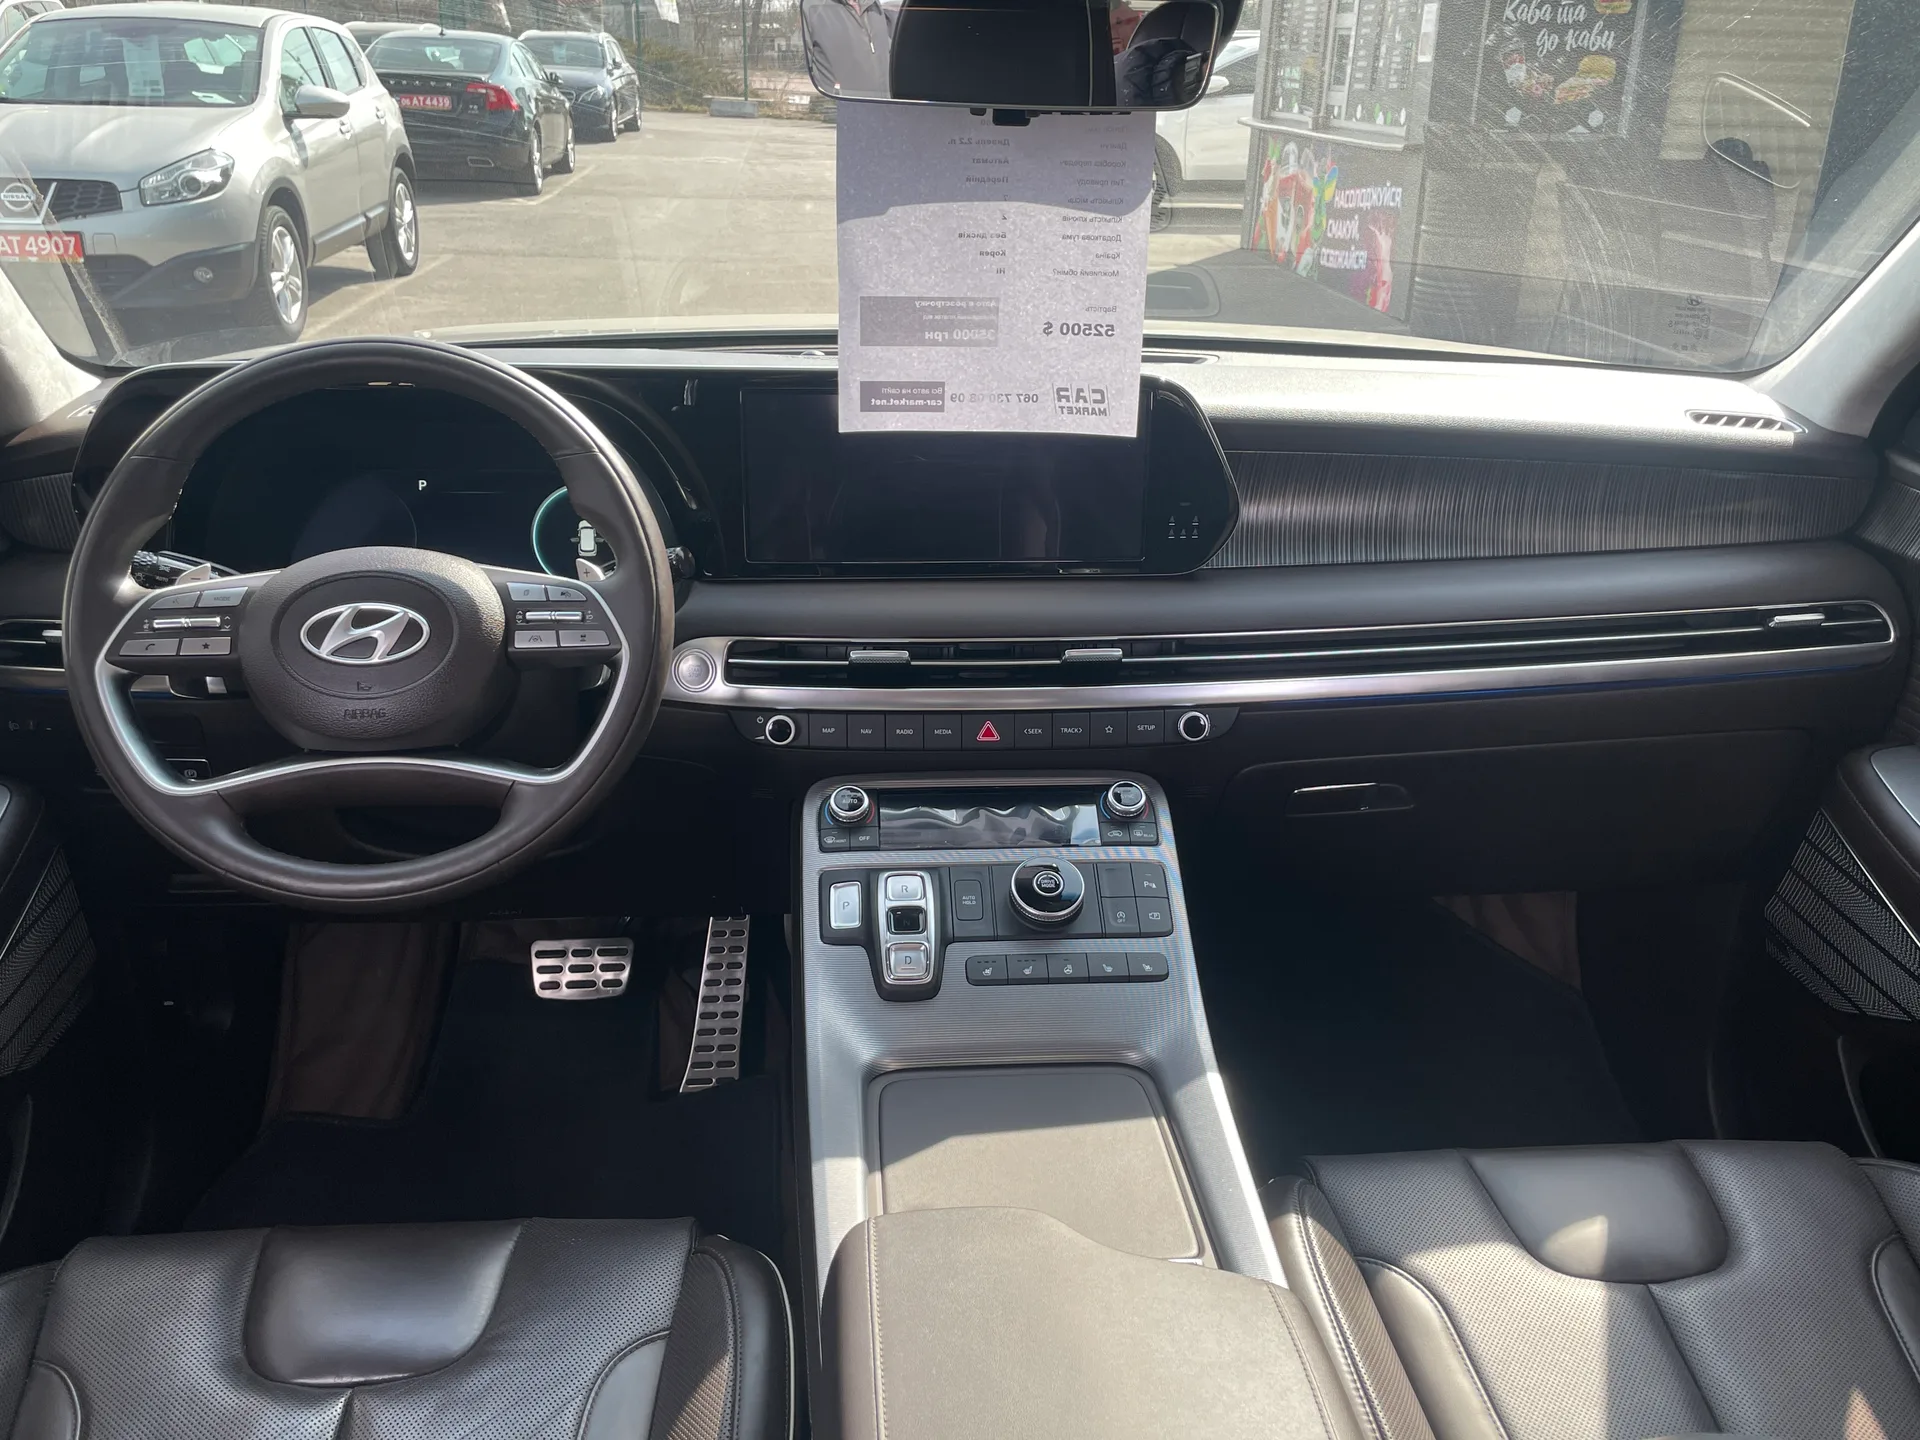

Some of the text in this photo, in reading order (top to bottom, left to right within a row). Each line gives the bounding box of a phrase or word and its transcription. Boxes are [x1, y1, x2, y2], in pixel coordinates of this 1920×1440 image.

[1536, 20, 1616, 58] до кави
[25, 236, 76, 255] 4907
[418, 480, 427, 491] P
[343, 707, 387, 720] AIRBAG
[901, 884, 908, 893] R
[842, 901, 850, 910] P
[904, 955, 912, 965] D
